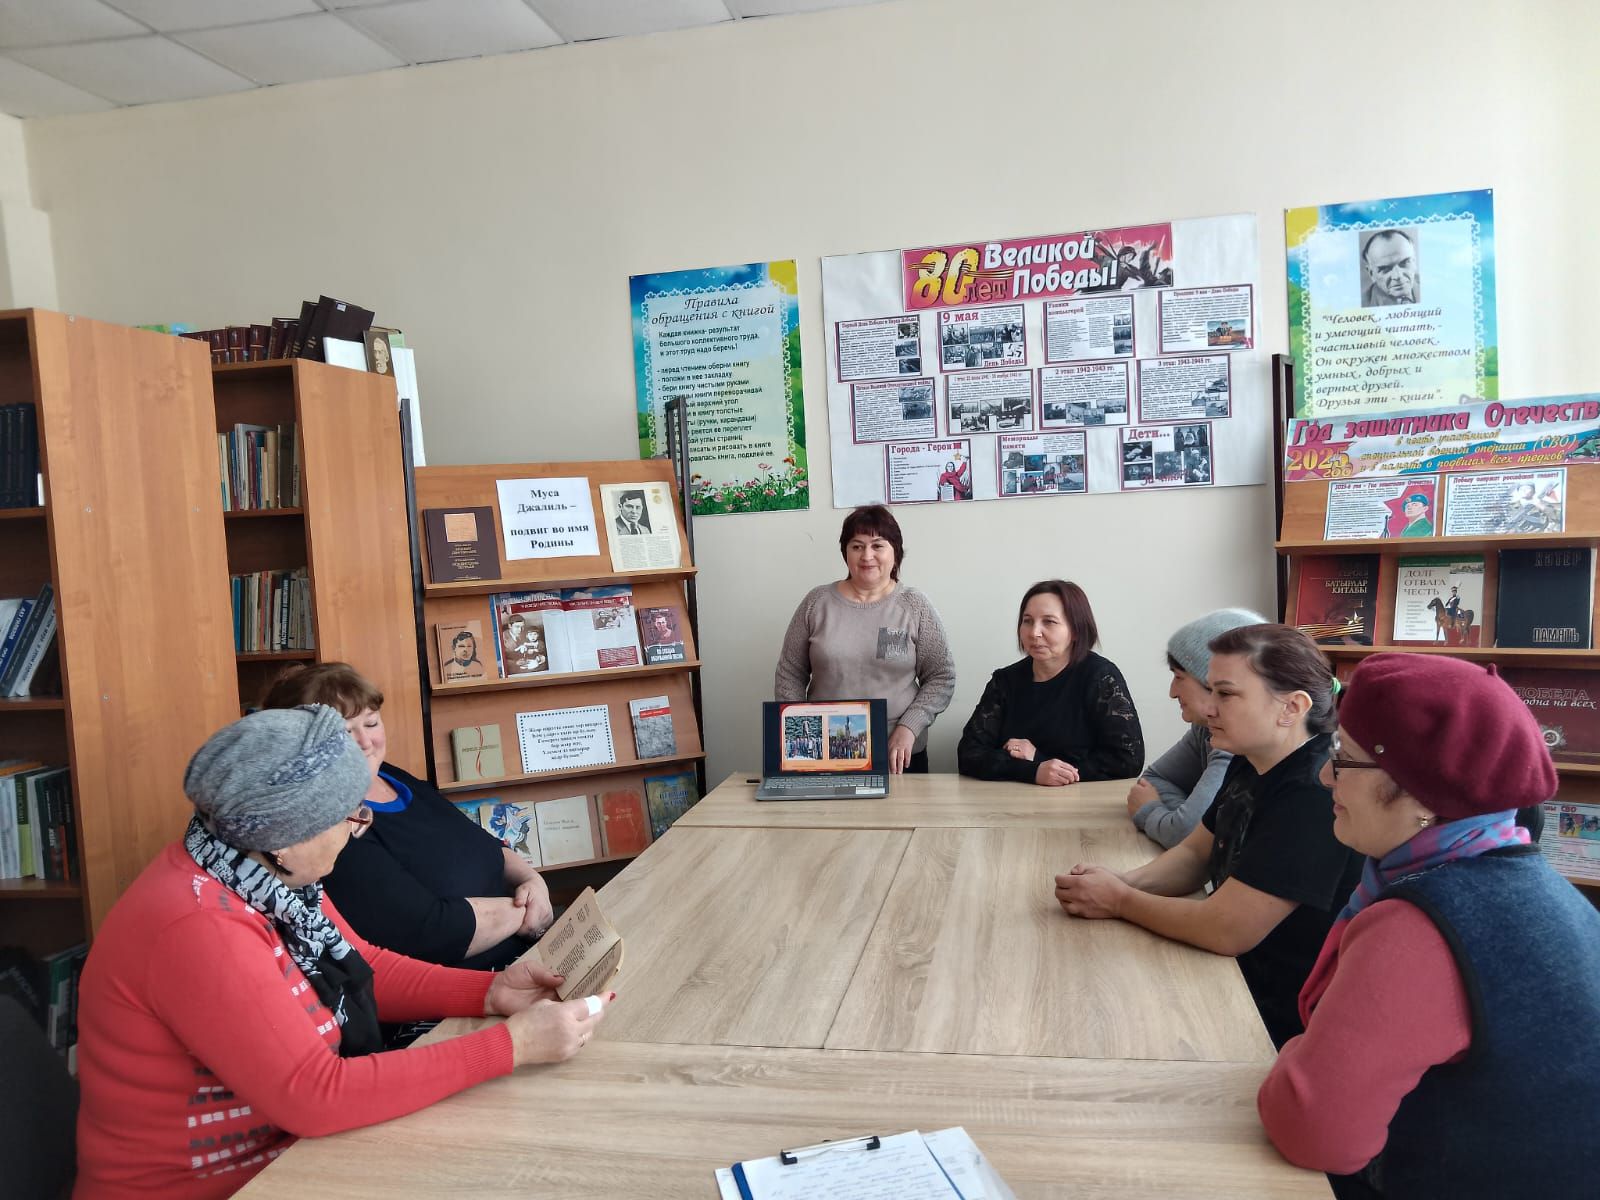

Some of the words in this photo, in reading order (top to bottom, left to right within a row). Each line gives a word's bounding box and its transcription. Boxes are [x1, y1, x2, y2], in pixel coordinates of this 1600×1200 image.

[984, 234, 1095, 269] Великой
[911, 248, 980, 308] 80
[1013, 260, 1118, 299] Победы!
[964, 279, 1008, 301] лет
[684, 296, 738, 311] Правила
[651, 312, 718, 327] обращения
[732, 304, 775, 319] книгой
[943, 312, 950, 323] 9
[955, 312, 978, 322] мая
[1385, 307, 1442, 322] любящий
[708, 326, 740, 334] результат
[1323, 326, 1381, 341] умеющий
[1385, 323, 1435, 334] читать,
[692, 335, 738, 345] коллективного
[1315, 339, 1386, 353] счастливый
[713, 343, 738, 352] беречь!
[1316, 357, 1333, 367] Он
[1335, 354, 1387, 367] окружен
[1392, 348, 1470, 361] множеством
[708, 362, 731, 370] оберни
[733, 360, 749, 368] книгу
[705, 371, 732, 379] закладку
[1315, 371, 1362, 382] умных,
[1366, 365, 1410, 378] добрых
[1415, 365, 1422, 373] и
[662, 385, 677, 393] бери
[679, 383, 695, 392] книгу
[726, 379, 749, 388] руками
[713, 387, 762, 397] переворачивай
[1316, 384, 1360, 396] верных
[1361, 380, 1404, 393] друзей.
[1316, 396, 1361, 410] Друзья
[1364, 395, 1388, 405] эти
[698, 419, 719, 427] (ручки,
[720, 415, 756, 424] карандаши)
[1293, 419, 1333, 445] Год
[1484, 401, 1600, 428] Отечеств
[722, 425, 752, 433] переплет
[1128, 429, 1170, 441] Дети...
[1405, 435, 1434, 445] честь
[1440, 428, 1501, 443] участников
[717, 443, 747, 452] рисовать
[891, 446, 920, 455] Города
[928, 443, 951, 452] Герои
[1360, 447, 1425, 461] специальной
[1429, 443, 1470, 457] военной
[1475, 443, 1526, 454] операции
[1533, 434, 1578, 450] (СВО)
[1287, 448, 1349, 471] 2025
[1381, 458, 1422, 470] память
[1437, 457, 1485, 469] подвигах
[1490, 453, 1512, 464] всех
[531, 489, 560, 499] Муса
[517, 503, 567, 514] Джалиль
[510, 527, 549, 536] подвиг
[568, 525, 589, 533] имя
[530, 540, 574, 549] Родины
[1404, 570, 1435, 578] ДОЛГ
[1325, 579, 1368, 587] БАТЫРЛАР
[1403, 588, 1440, 596] ЧЕСТЬ
[1533, 627, 1580, 643] ПАМЯТЬ
[1523, 698, 1550, 706] одна
[1571, 699, 1597, 709] всех
